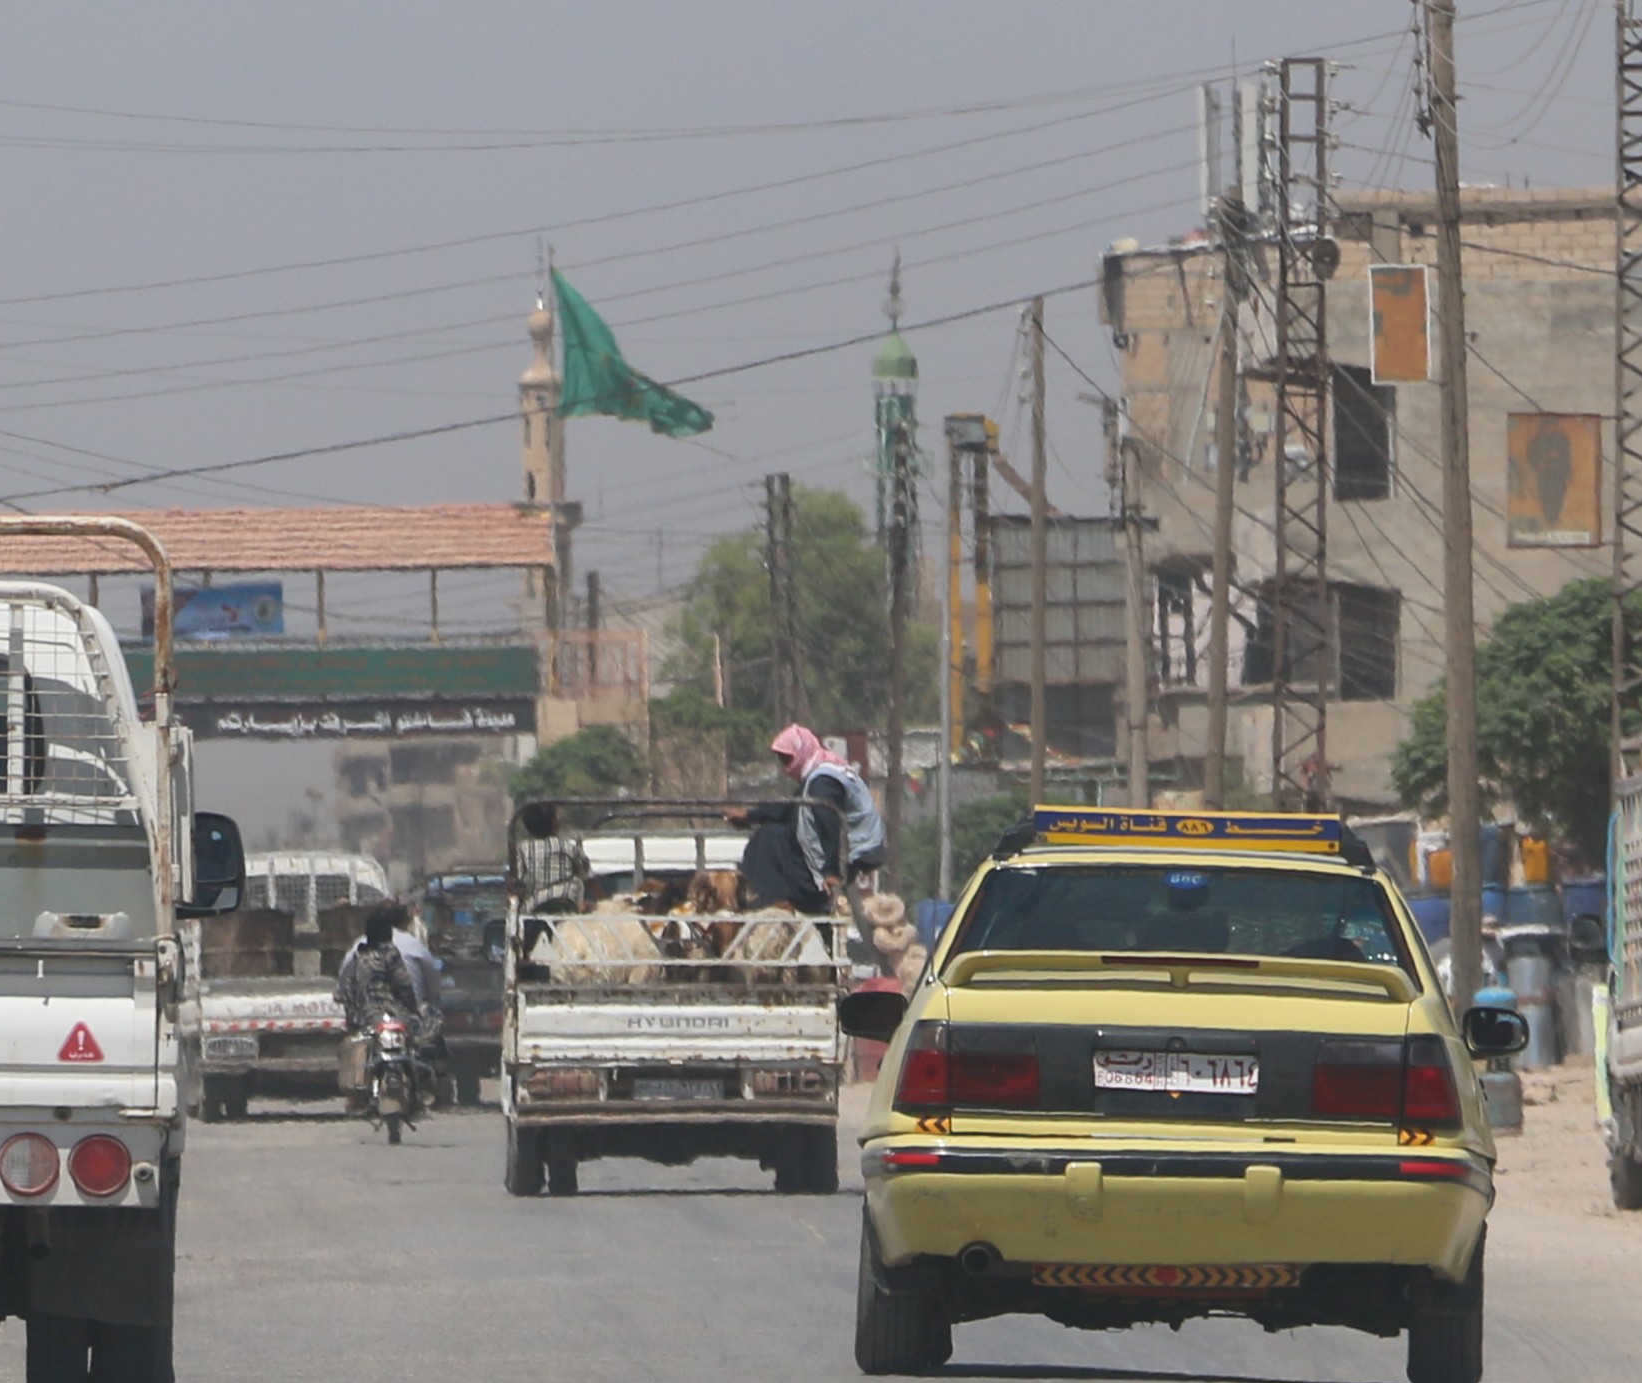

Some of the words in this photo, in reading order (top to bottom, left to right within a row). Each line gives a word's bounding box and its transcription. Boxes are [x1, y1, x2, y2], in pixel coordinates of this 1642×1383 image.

[1049, 814, 1114, 833] السويس
[1119, 815, 1167, 832] قناة
[1177, 821, 1212, 835] ٨٨٦
[1224, 820, 1324, 835] خط
[627, 1017, 729, 1028] HYUNDAI
